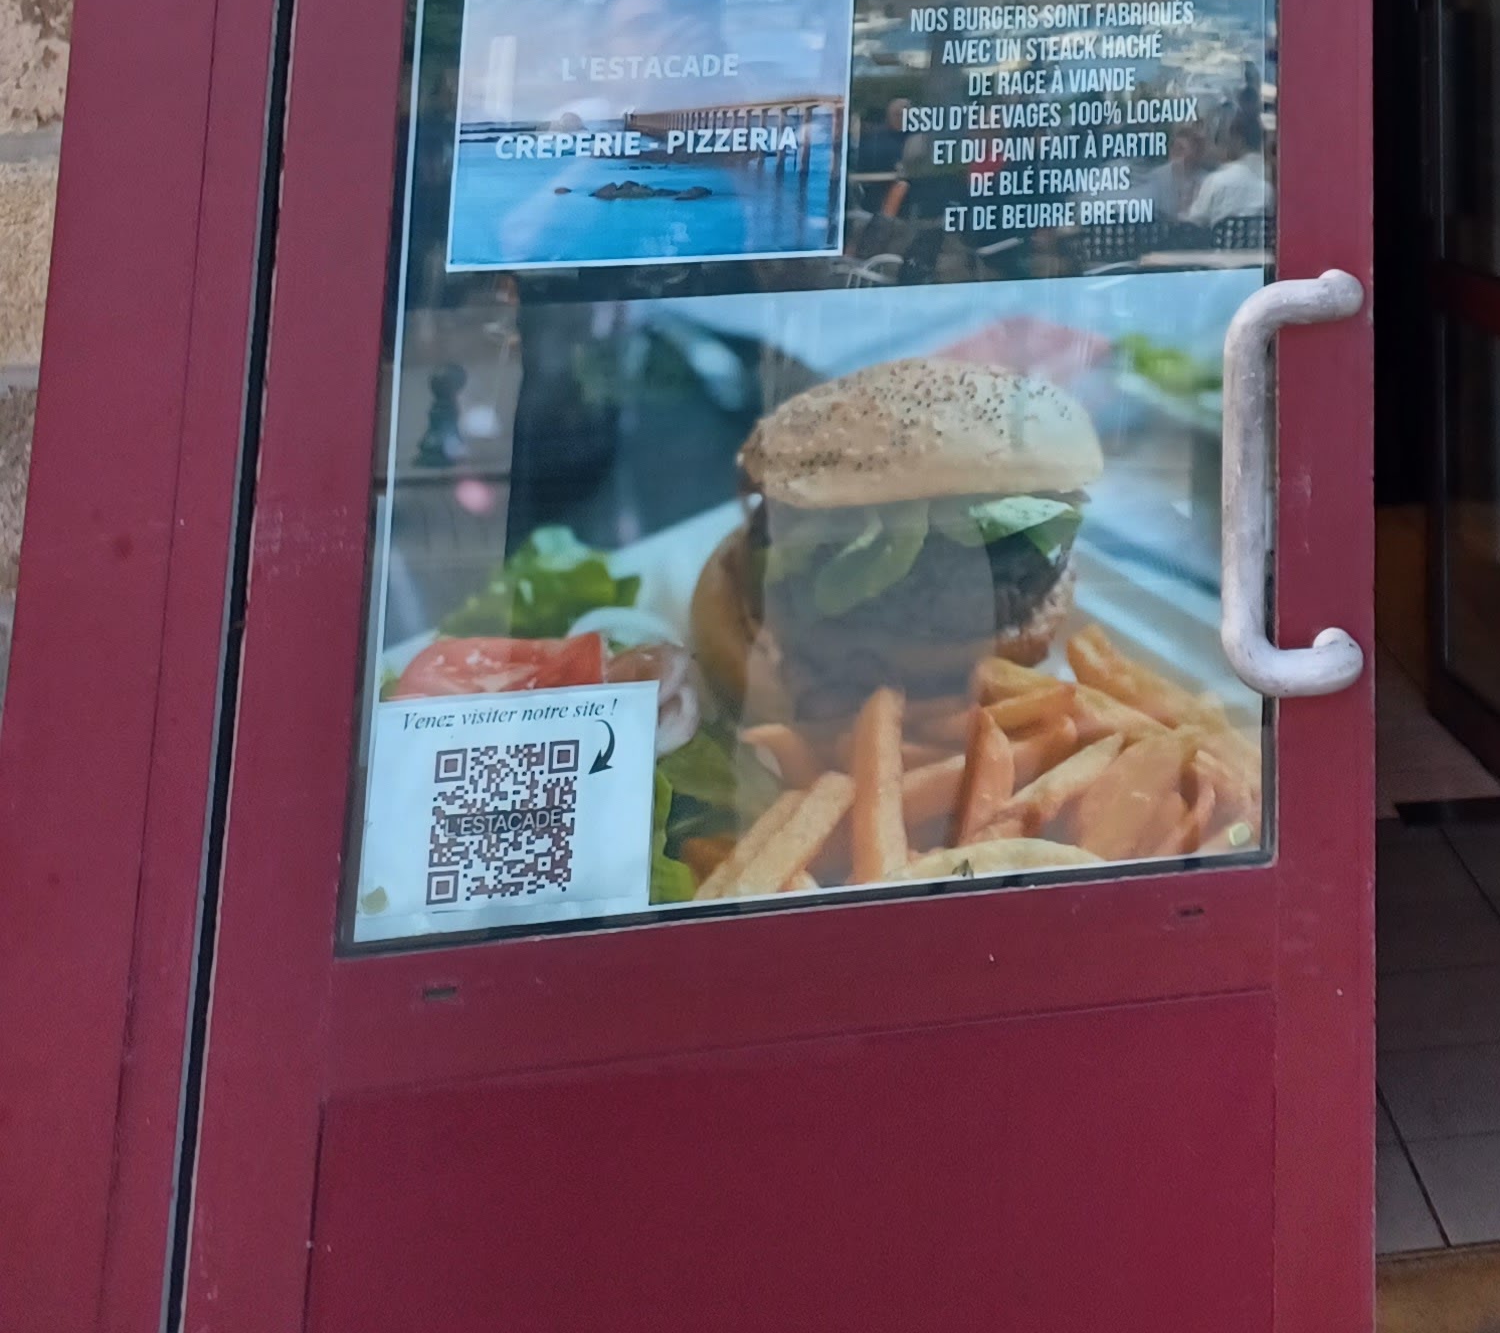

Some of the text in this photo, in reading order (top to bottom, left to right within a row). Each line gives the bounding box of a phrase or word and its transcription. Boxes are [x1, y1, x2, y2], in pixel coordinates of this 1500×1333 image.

[910, 7, 949, 33] NOS
[953, 4, 1039, 31] BURGERS
[1042, 2, 1092, 29] SONT
[941, 30, 1163, 65] AVEC UN STEACK HACHÉ
[561, 53, 740, 82] L'ESTACADE
[968, 65, 1137, 96] DE RACE À VIANDE
[902, 96, 1198, 133] ISSU D'ÉLEVAGES 100% LOCAUX
[494, 130, 642, 161] CREPERIE
[666, 126, 800, 156] PIZZERIA
[933, 129, 1167, 165] ET DU PAIN FAIT À PARTIR
[969, 165, 1131, 197] DE BLÉ FRANÇAIS
[944, 198, 1154, 232] ET DE BEURRE BRETON
[402, 712, 455, 732] Venez
[461, 707, 517, 726] visiter
[521, 704, 570, 721] notre
[572, 700, 605, 718] site
[443, 808, 562, 837] L'ESTACADE
